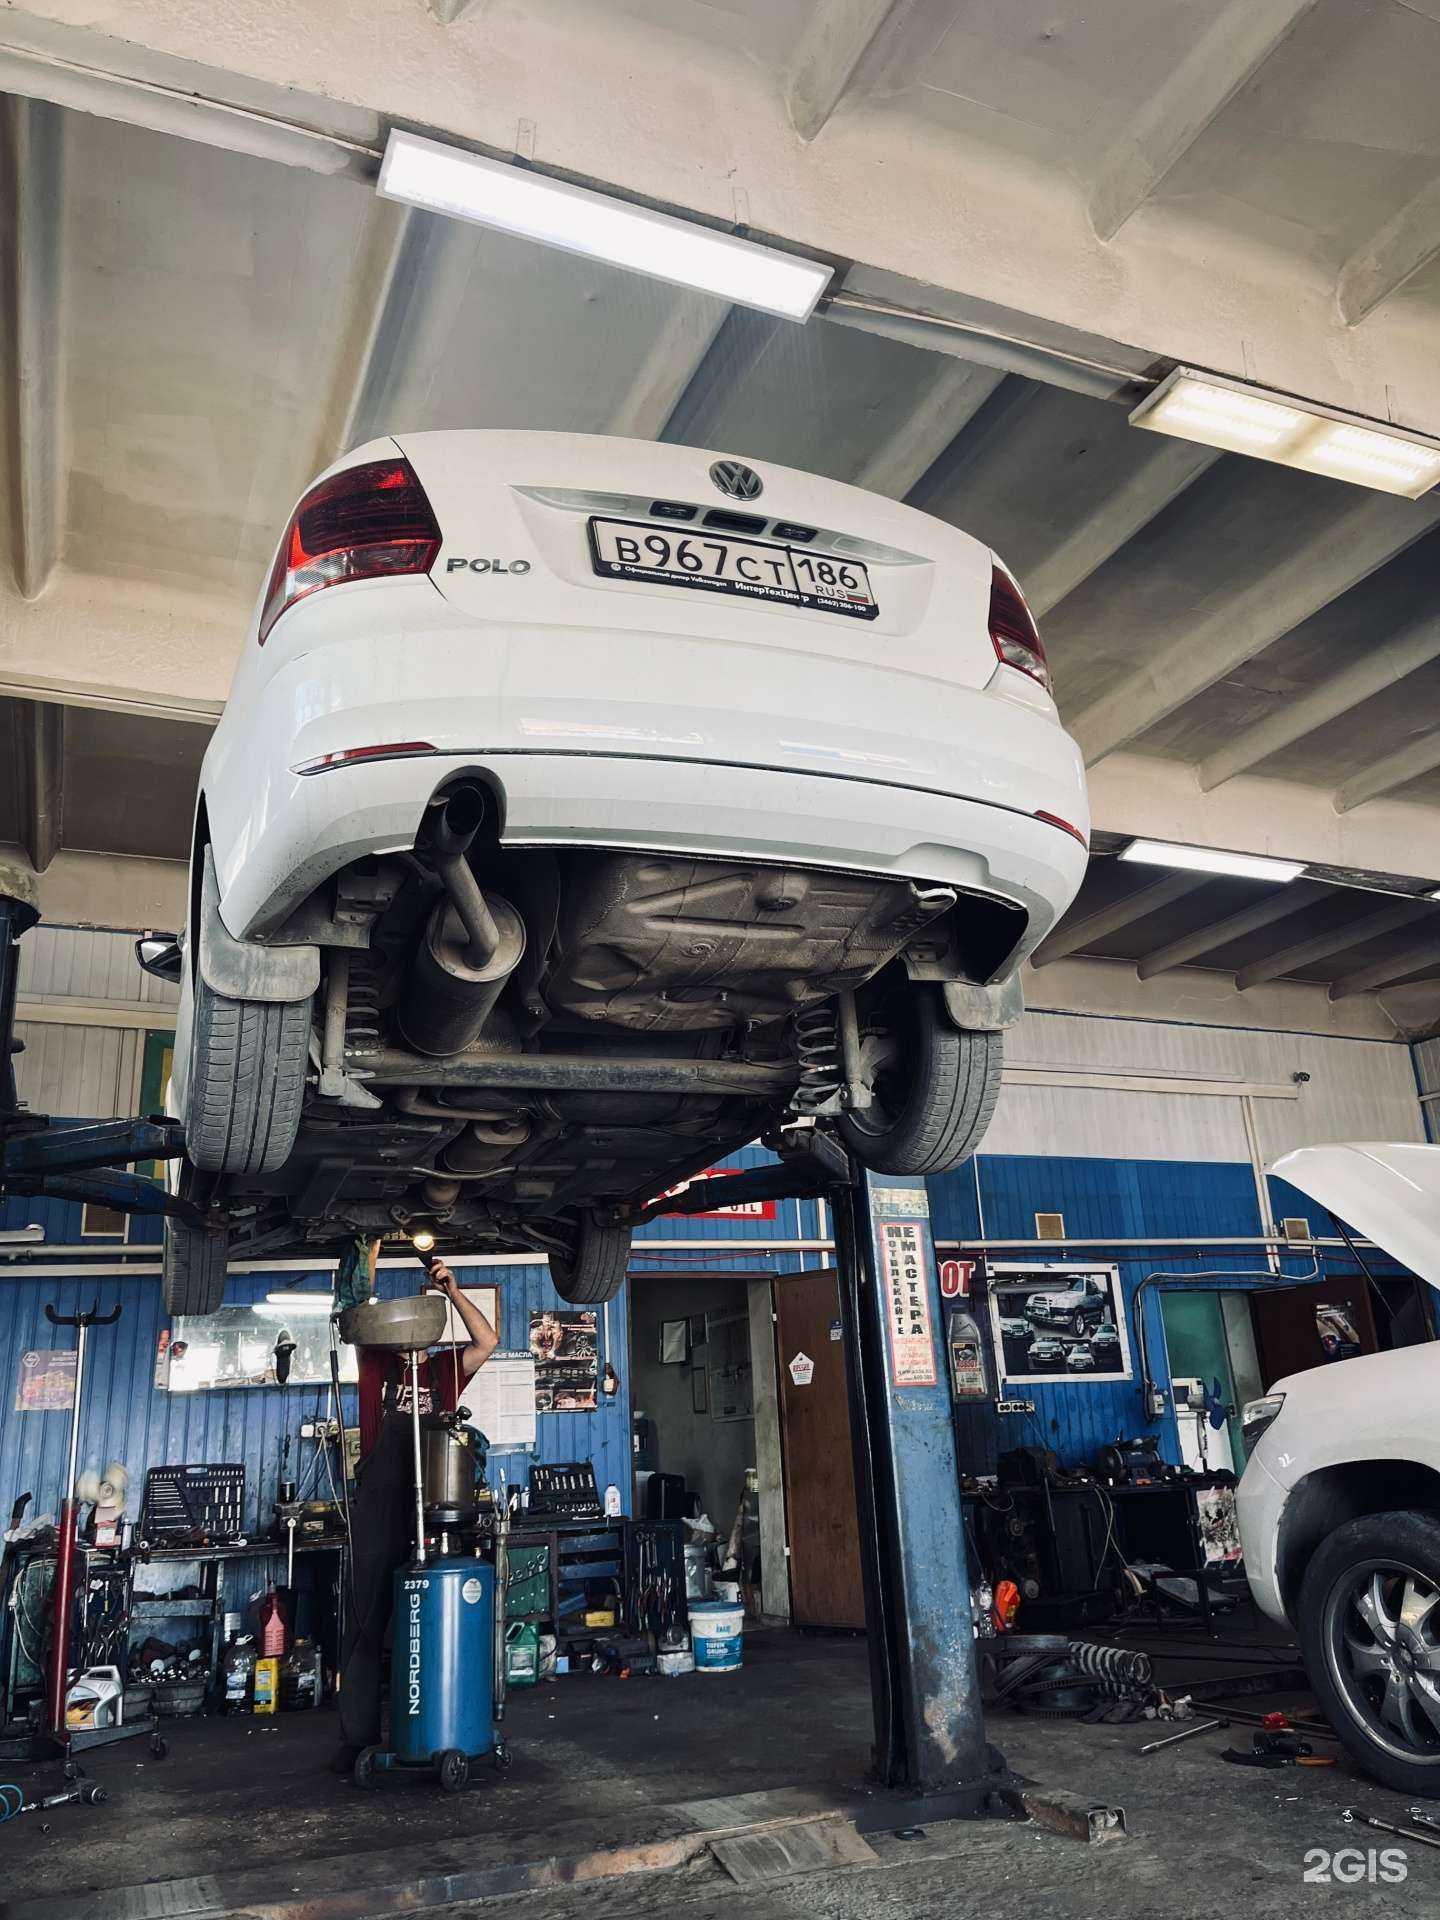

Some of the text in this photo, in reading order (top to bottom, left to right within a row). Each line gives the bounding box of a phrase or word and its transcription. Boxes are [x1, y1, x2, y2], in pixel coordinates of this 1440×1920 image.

[446, 558, 531, 575] POLO
[615, 535, 858, 590] В967СТ 186
[690, 575, 728, 588] Volkswagen
[815, 585, 847, 599] RUS
[901, 1240, 923, 1335] МАСТЕРА
[508, 1351, 533, 1359] МАСЛА
[404, 1579, 430, 1590] 2379
[408, 1593, 421, 1715] NORDBERG
